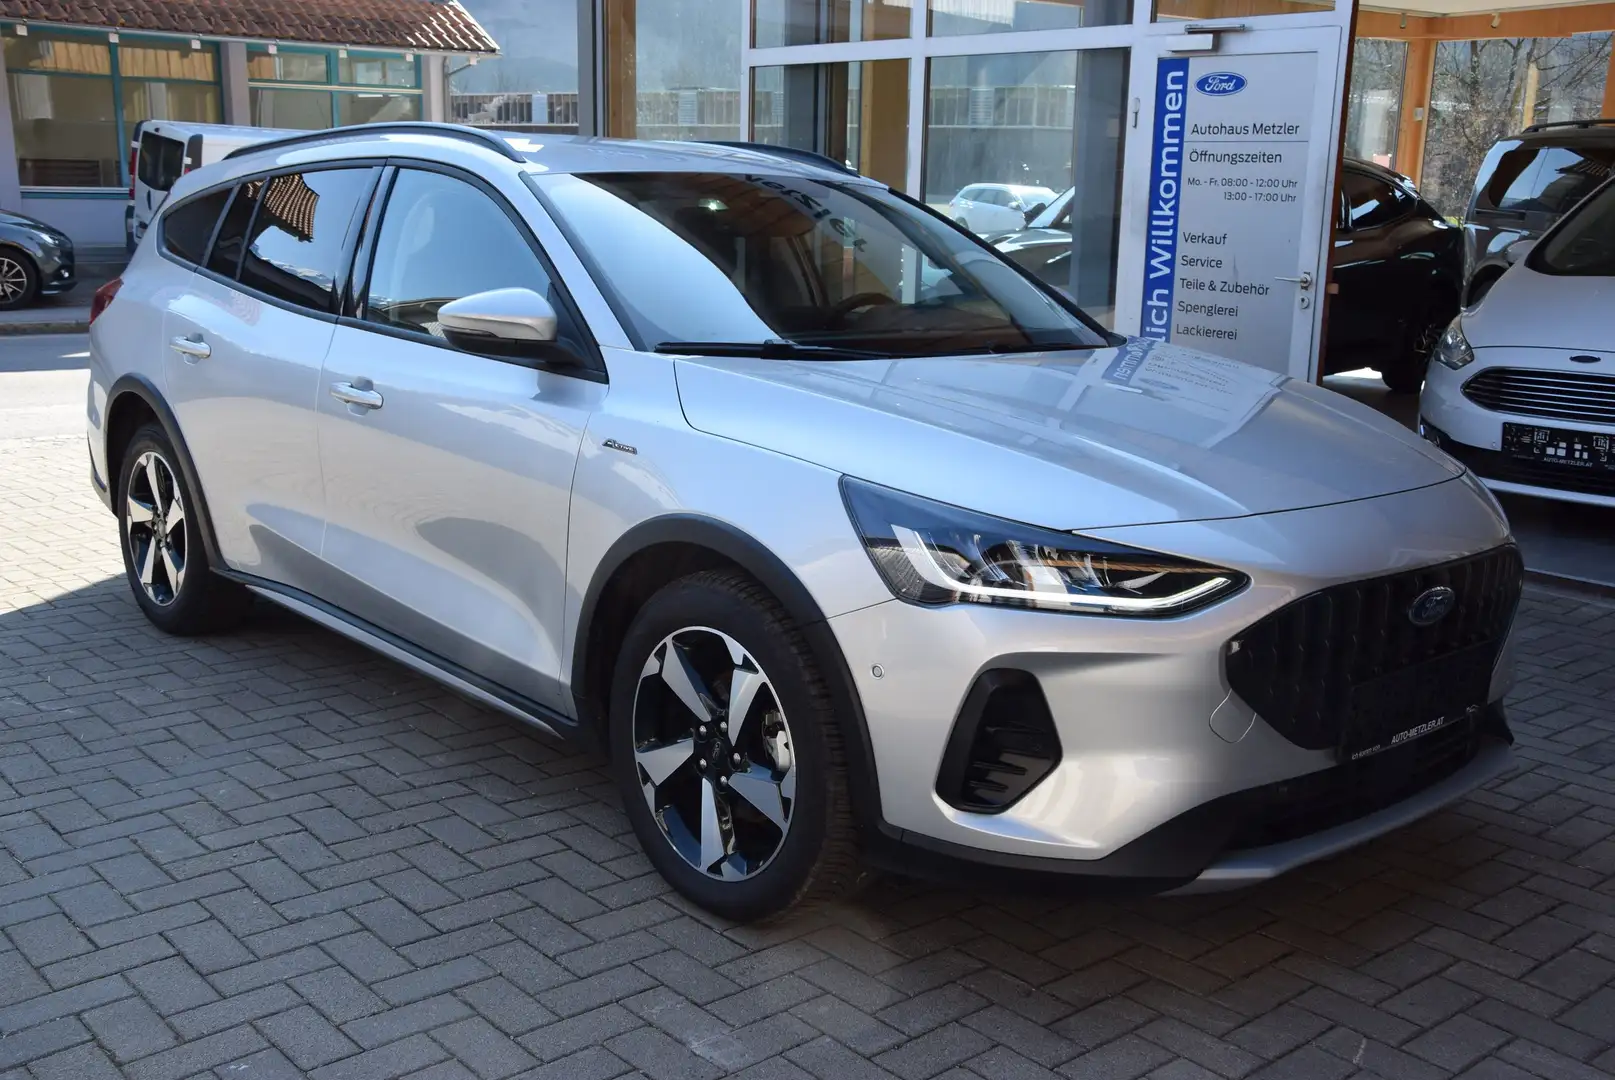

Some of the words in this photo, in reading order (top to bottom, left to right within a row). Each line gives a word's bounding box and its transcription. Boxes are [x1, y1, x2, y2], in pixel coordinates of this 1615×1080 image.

[1190, 123, 1249, 135] Autohaus
[1252, 122, 1300, 135] Metzler
[1189, 147, 1282, 165] Öffnungszeiten
[1150, 70, 1184, 279] Willkommen
[1187, 177, 1202, 186] Mo.
[1209, 177, 1219, 186] Fr.
[1221, 178, 1248, 187] 08:00
[1255, 178, 1280, 188] 12:00
[1281, 179, 1298, 188] Uhr
[1223, 191, 1247, 201] 13:00
[1254, 192, 1279, 202] 17:00
[1280, 193, 1297, 203] Uhr
[1182, 231, 1228, 245] Verkauf
[1180, 254, 1223, 268] Service
[1179, 278, 1206, 291] Teile
[1208, 280, 1216, 291] &
[1220, 281, 1270, 296] Zubehör
[1177, 300, 1239, 317] Spenglerei
[1176, 323, 1238, 340] Lackiererei
[1391, 716, 1445, 745] AUTO-METZLER.AT
